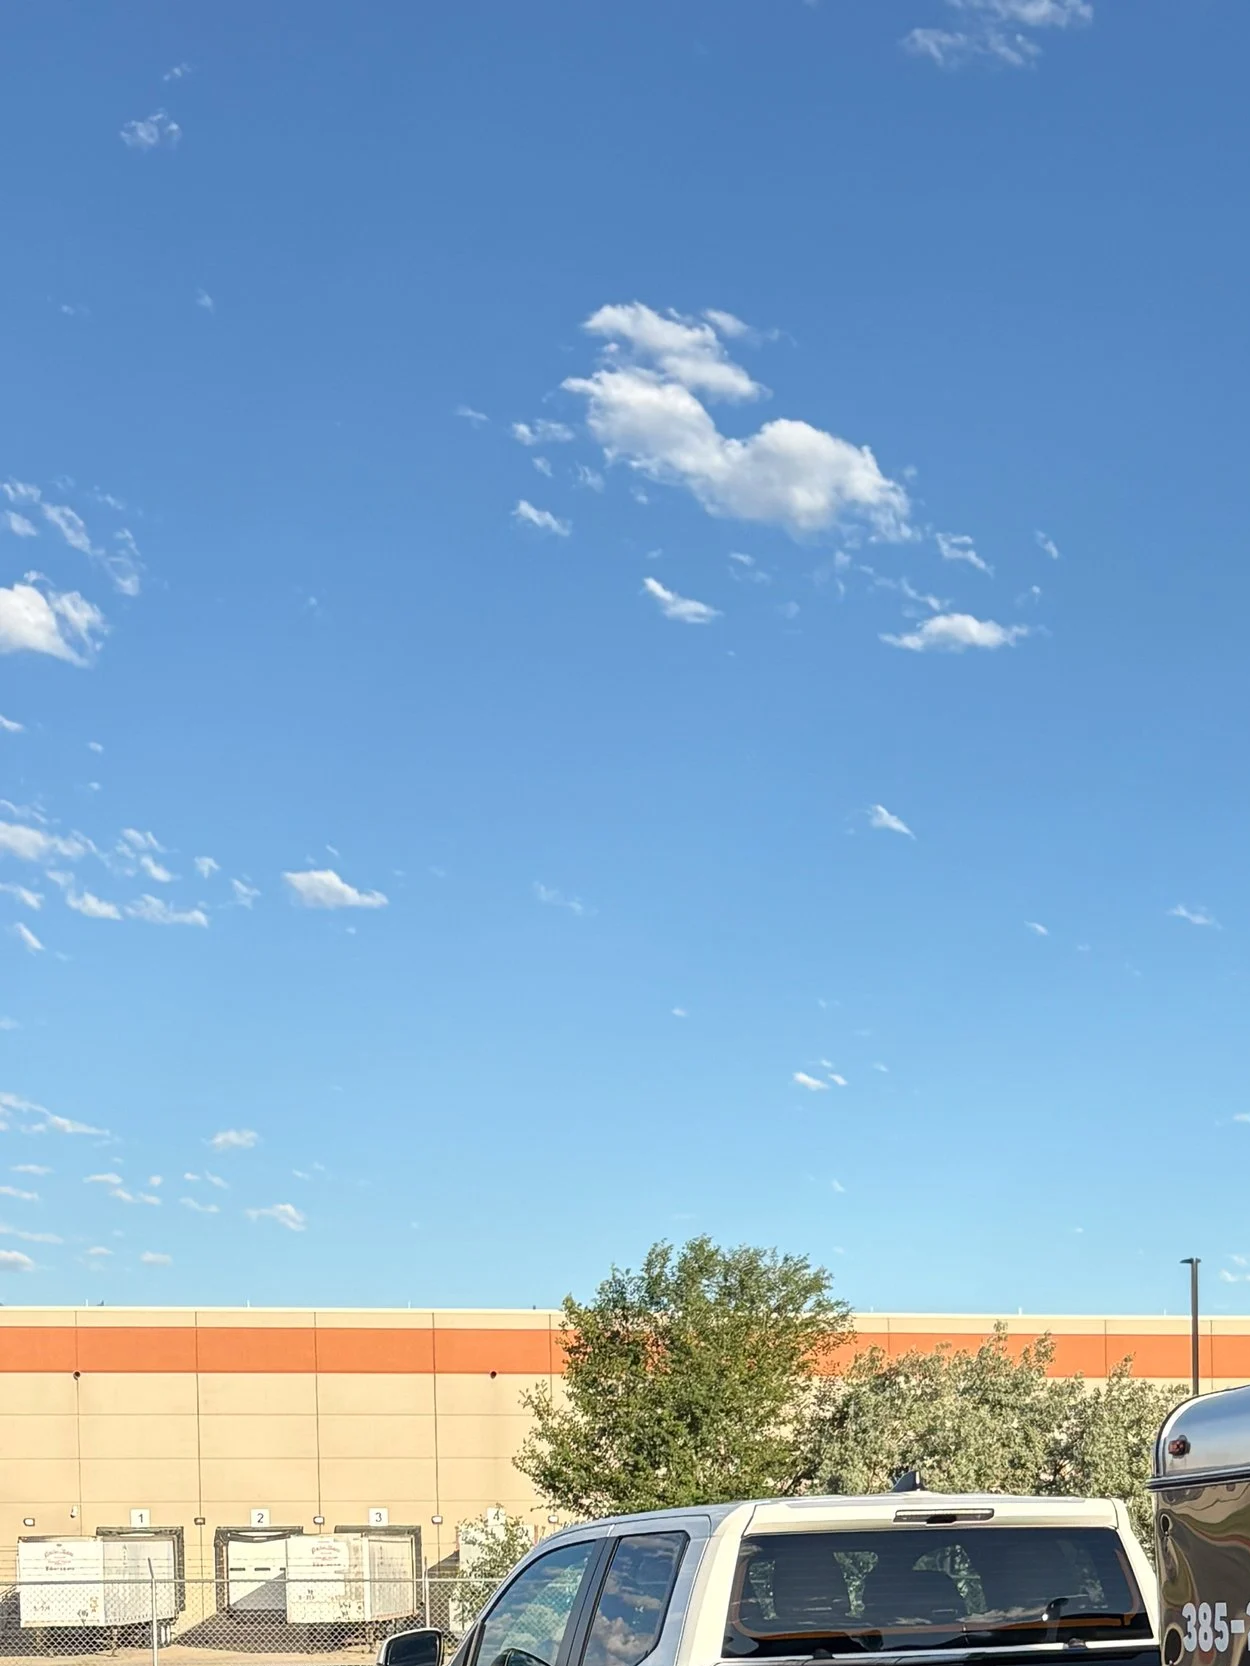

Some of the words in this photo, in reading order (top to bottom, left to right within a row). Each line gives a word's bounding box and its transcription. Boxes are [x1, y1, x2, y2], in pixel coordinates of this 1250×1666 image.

[137, 1513, 144, 1524] 1
[256, 1512, 265, 1524] 2
[374, 1511, 383, 1523] 3
